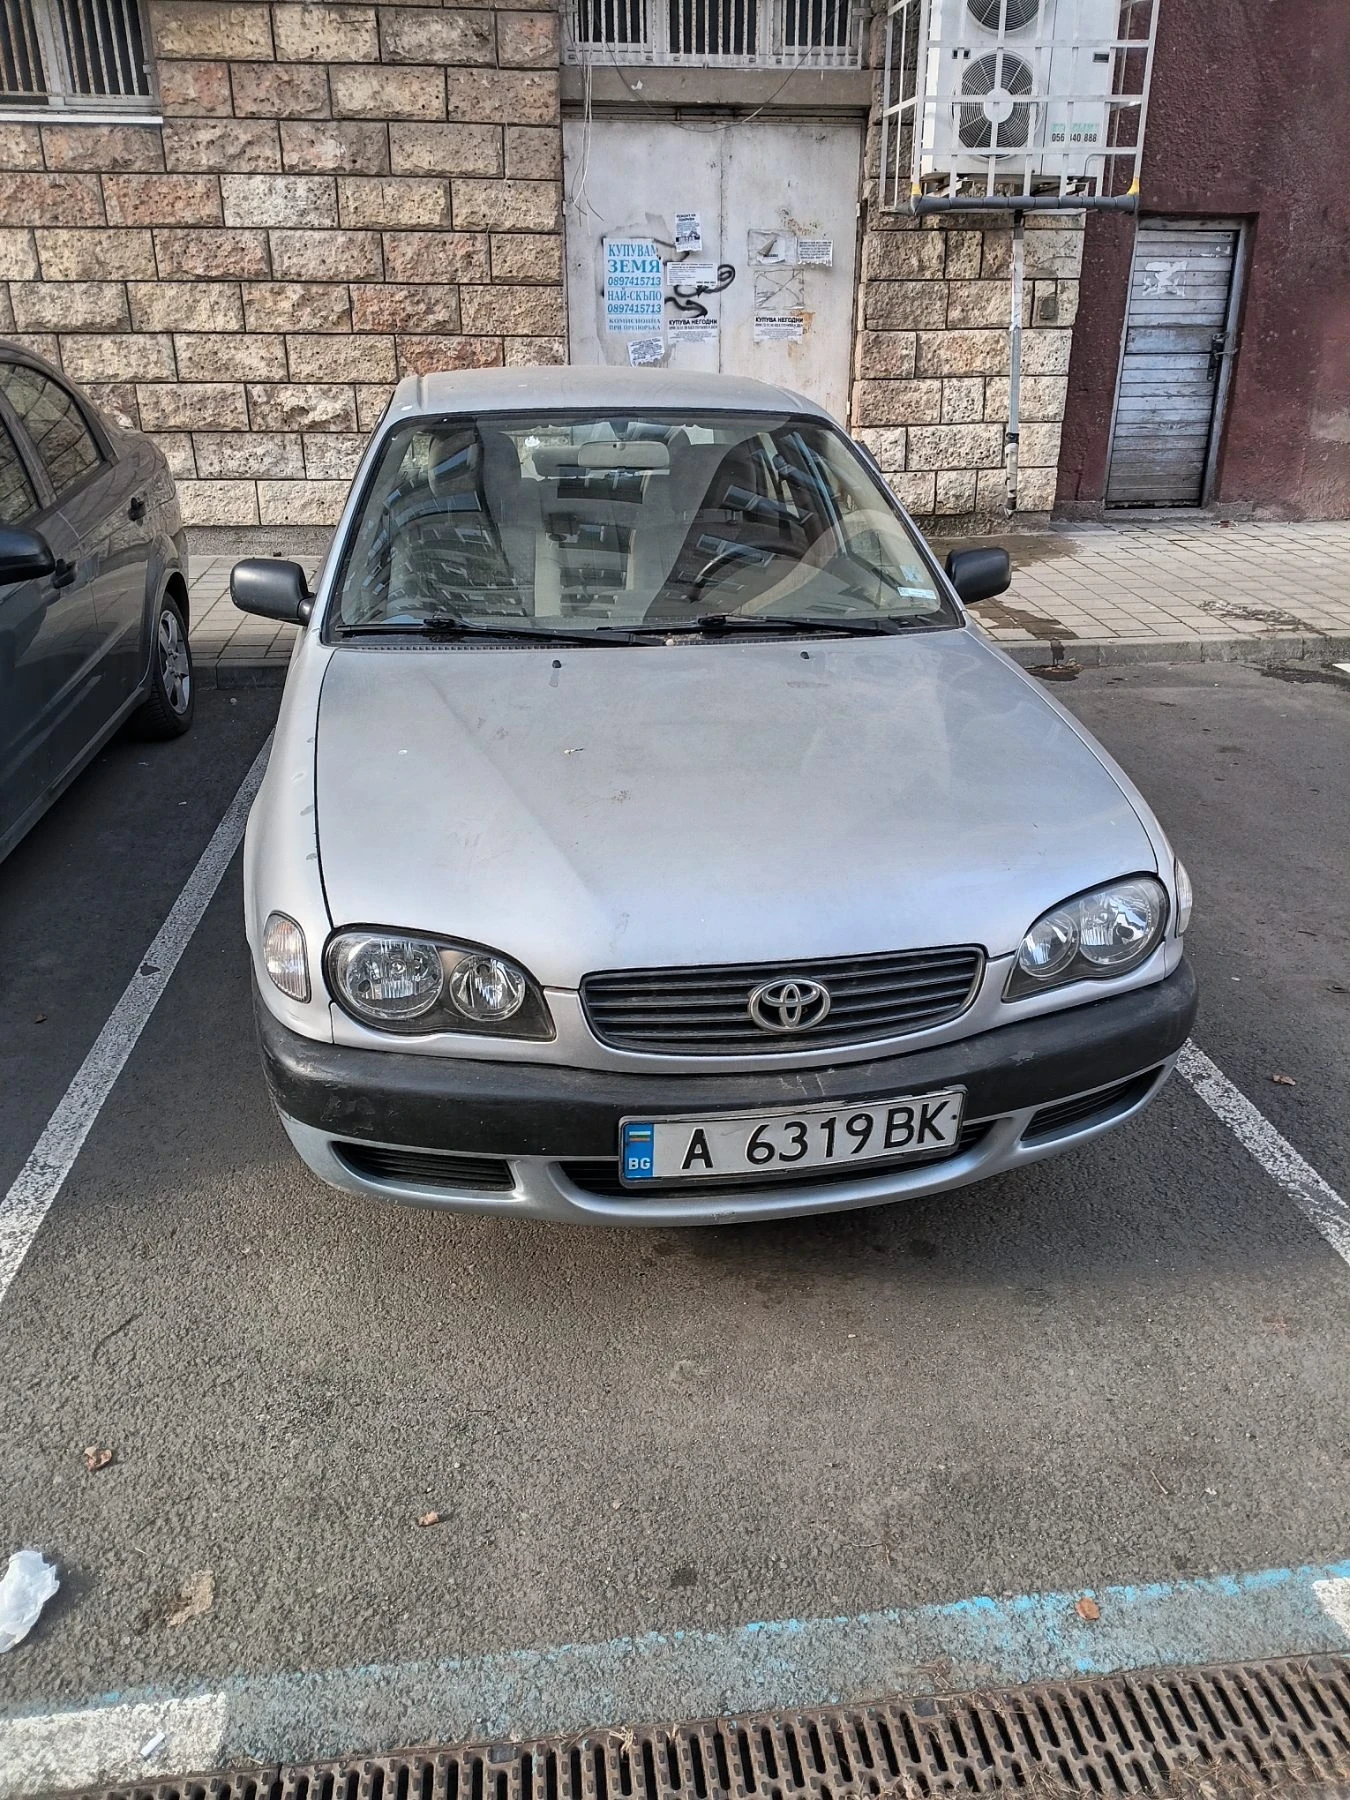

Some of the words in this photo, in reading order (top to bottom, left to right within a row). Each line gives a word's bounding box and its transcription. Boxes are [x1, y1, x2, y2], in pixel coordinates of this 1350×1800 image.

[1051, 133, 1065, 142] 056
[1084, 133, 1098, 142] 888
[607, 259, 662, 274] ЗЕМЯ
[607, 276, 662, 286] 0897415713
[607, 286, 662, 301] НАЙ-СКЪПО
[607, 303, 662, 313] 0897415713
[627, 1157, 650, 1170] BG
